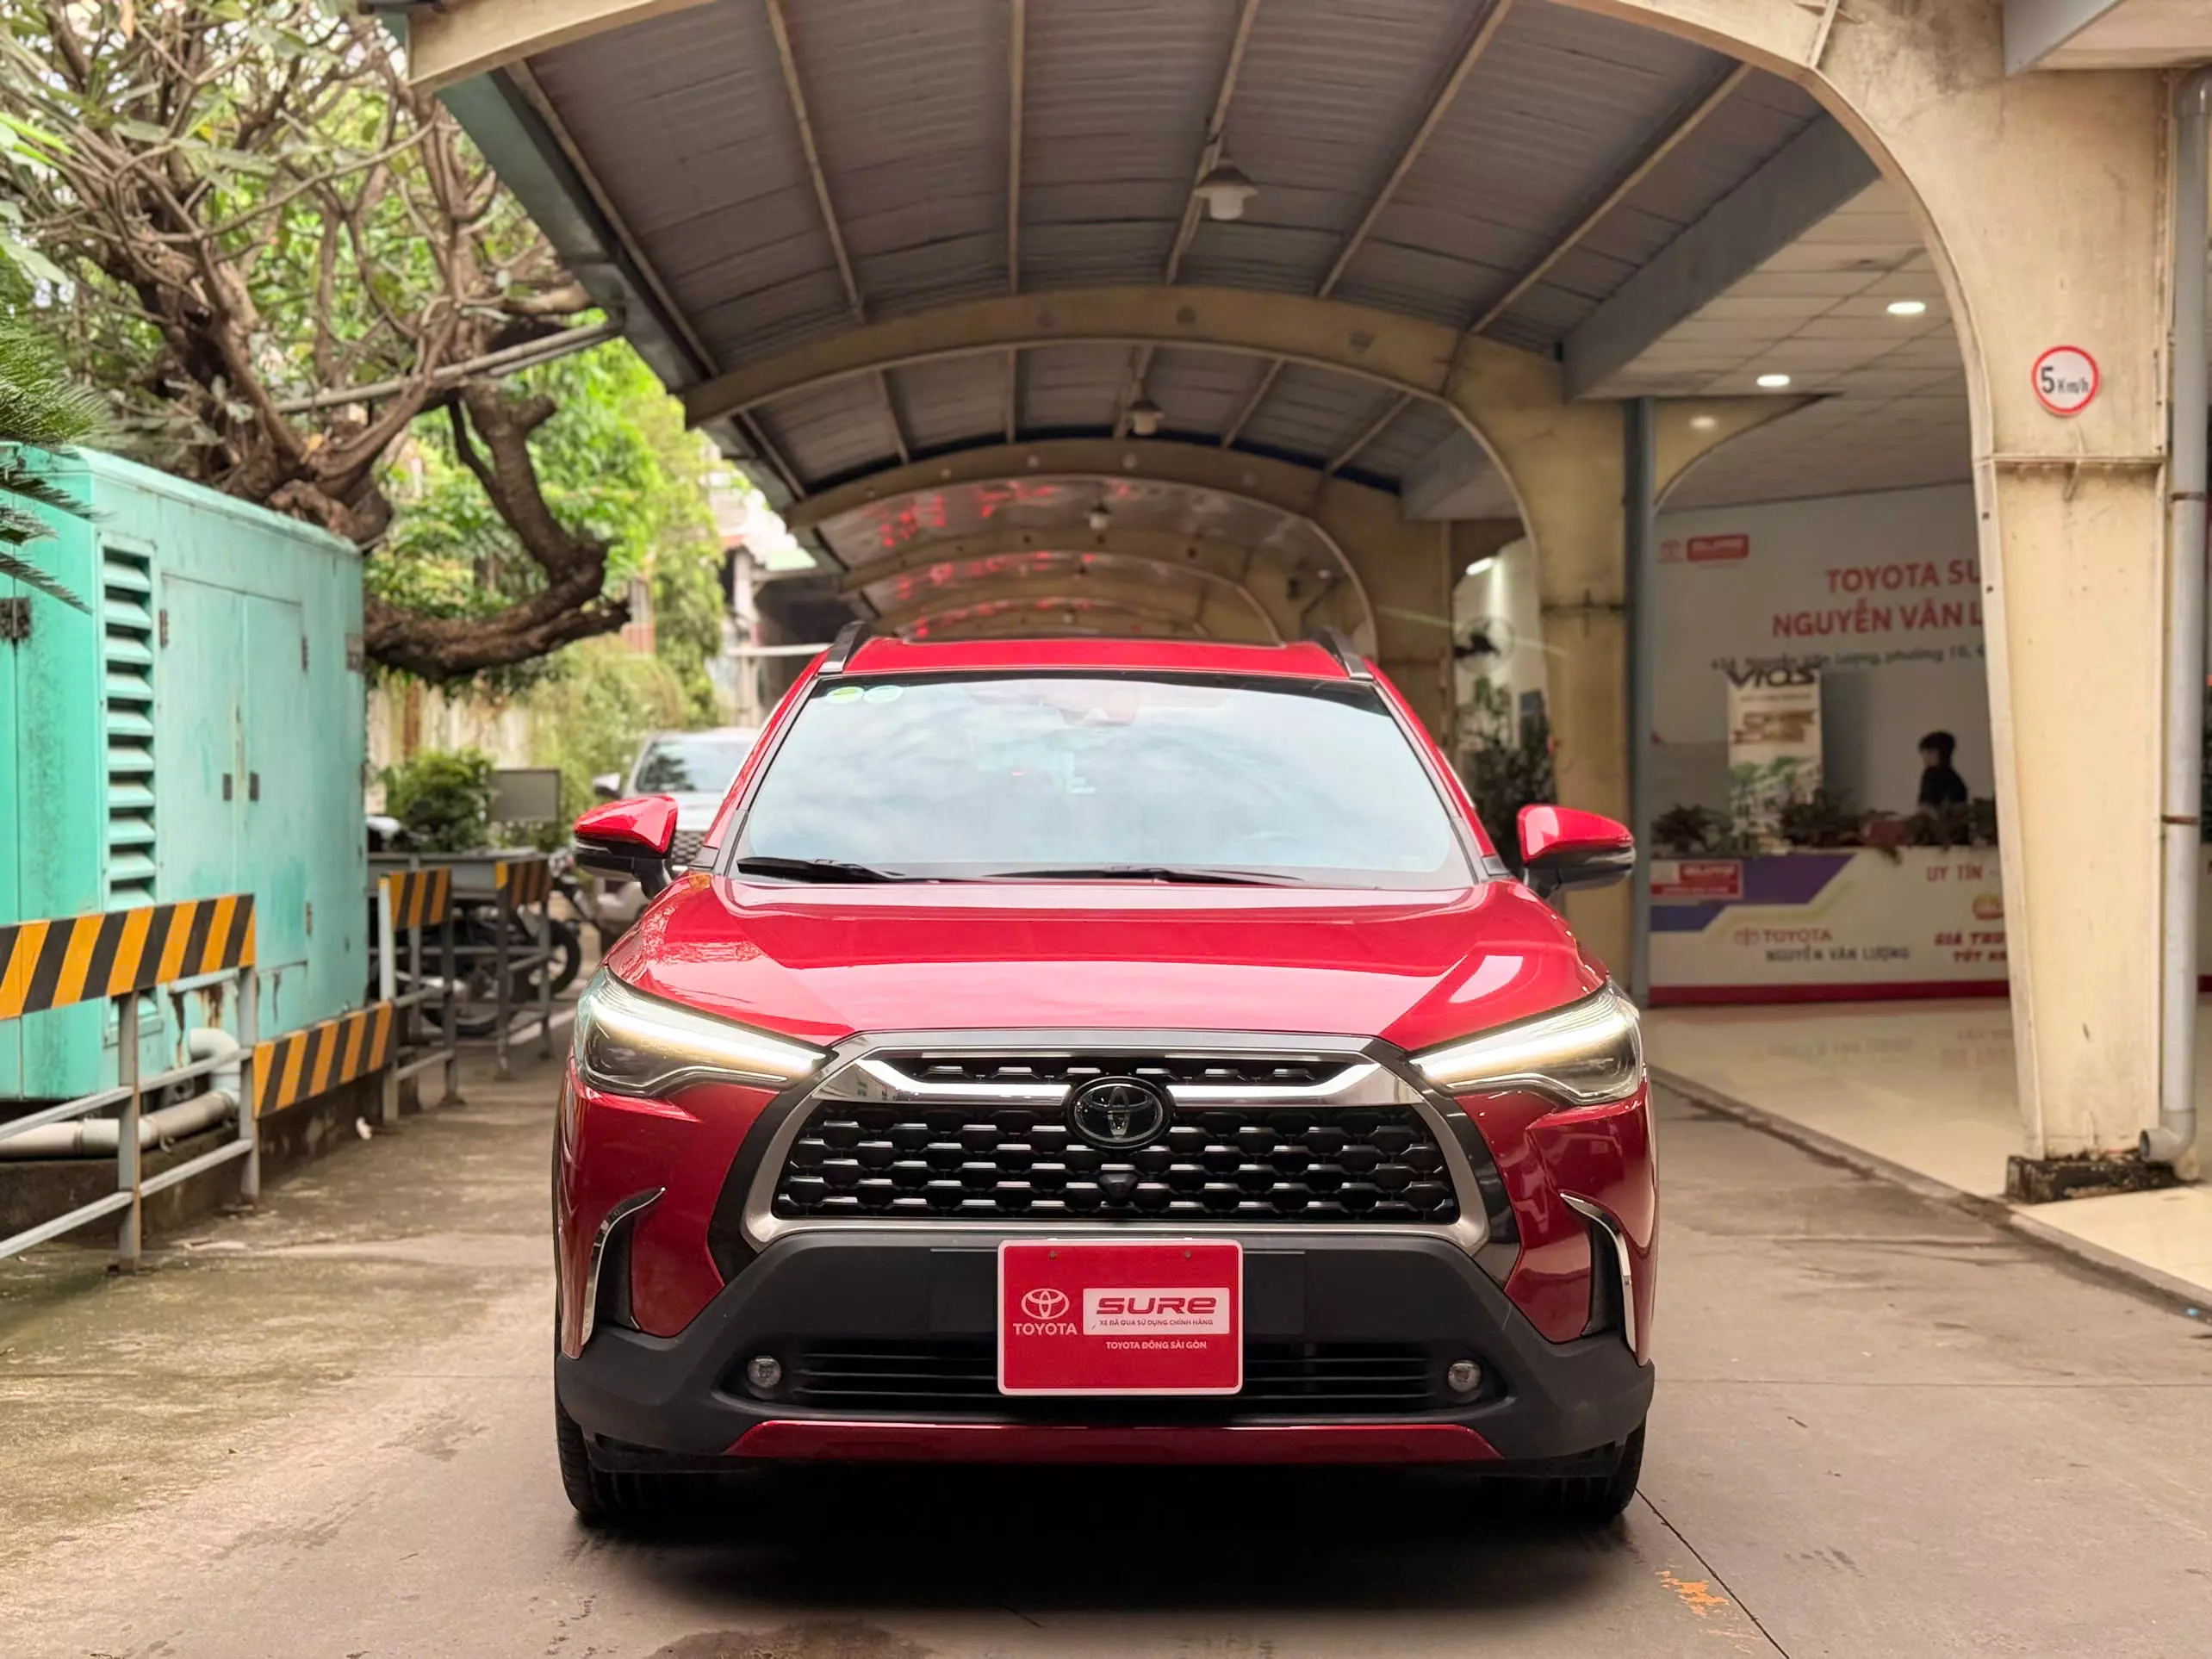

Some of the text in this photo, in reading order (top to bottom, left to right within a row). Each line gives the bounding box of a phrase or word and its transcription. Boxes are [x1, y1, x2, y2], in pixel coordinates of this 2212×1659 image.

[2040, 365, 2055, 395] 5
[1825, 561, 1941, 594] TOYOTA
[1772, 598, 1892, 638] NGUYỄN
[1898, 598, 1963, 631] VĂN
[1763, 927, 1833, 943] TOYOTA
[1012, 1322, 1078, 1336] TOYOTA
[1109, 1317, 1120, 1327] ĐÃ
[1147, 1319, 1168, 1327] DỤNG
[1169, 1317, 1191, 1327] CHÍNH
[1105, 1339, 1208, 1350] TOYOTA ĐÔNG SÀI GÒN
